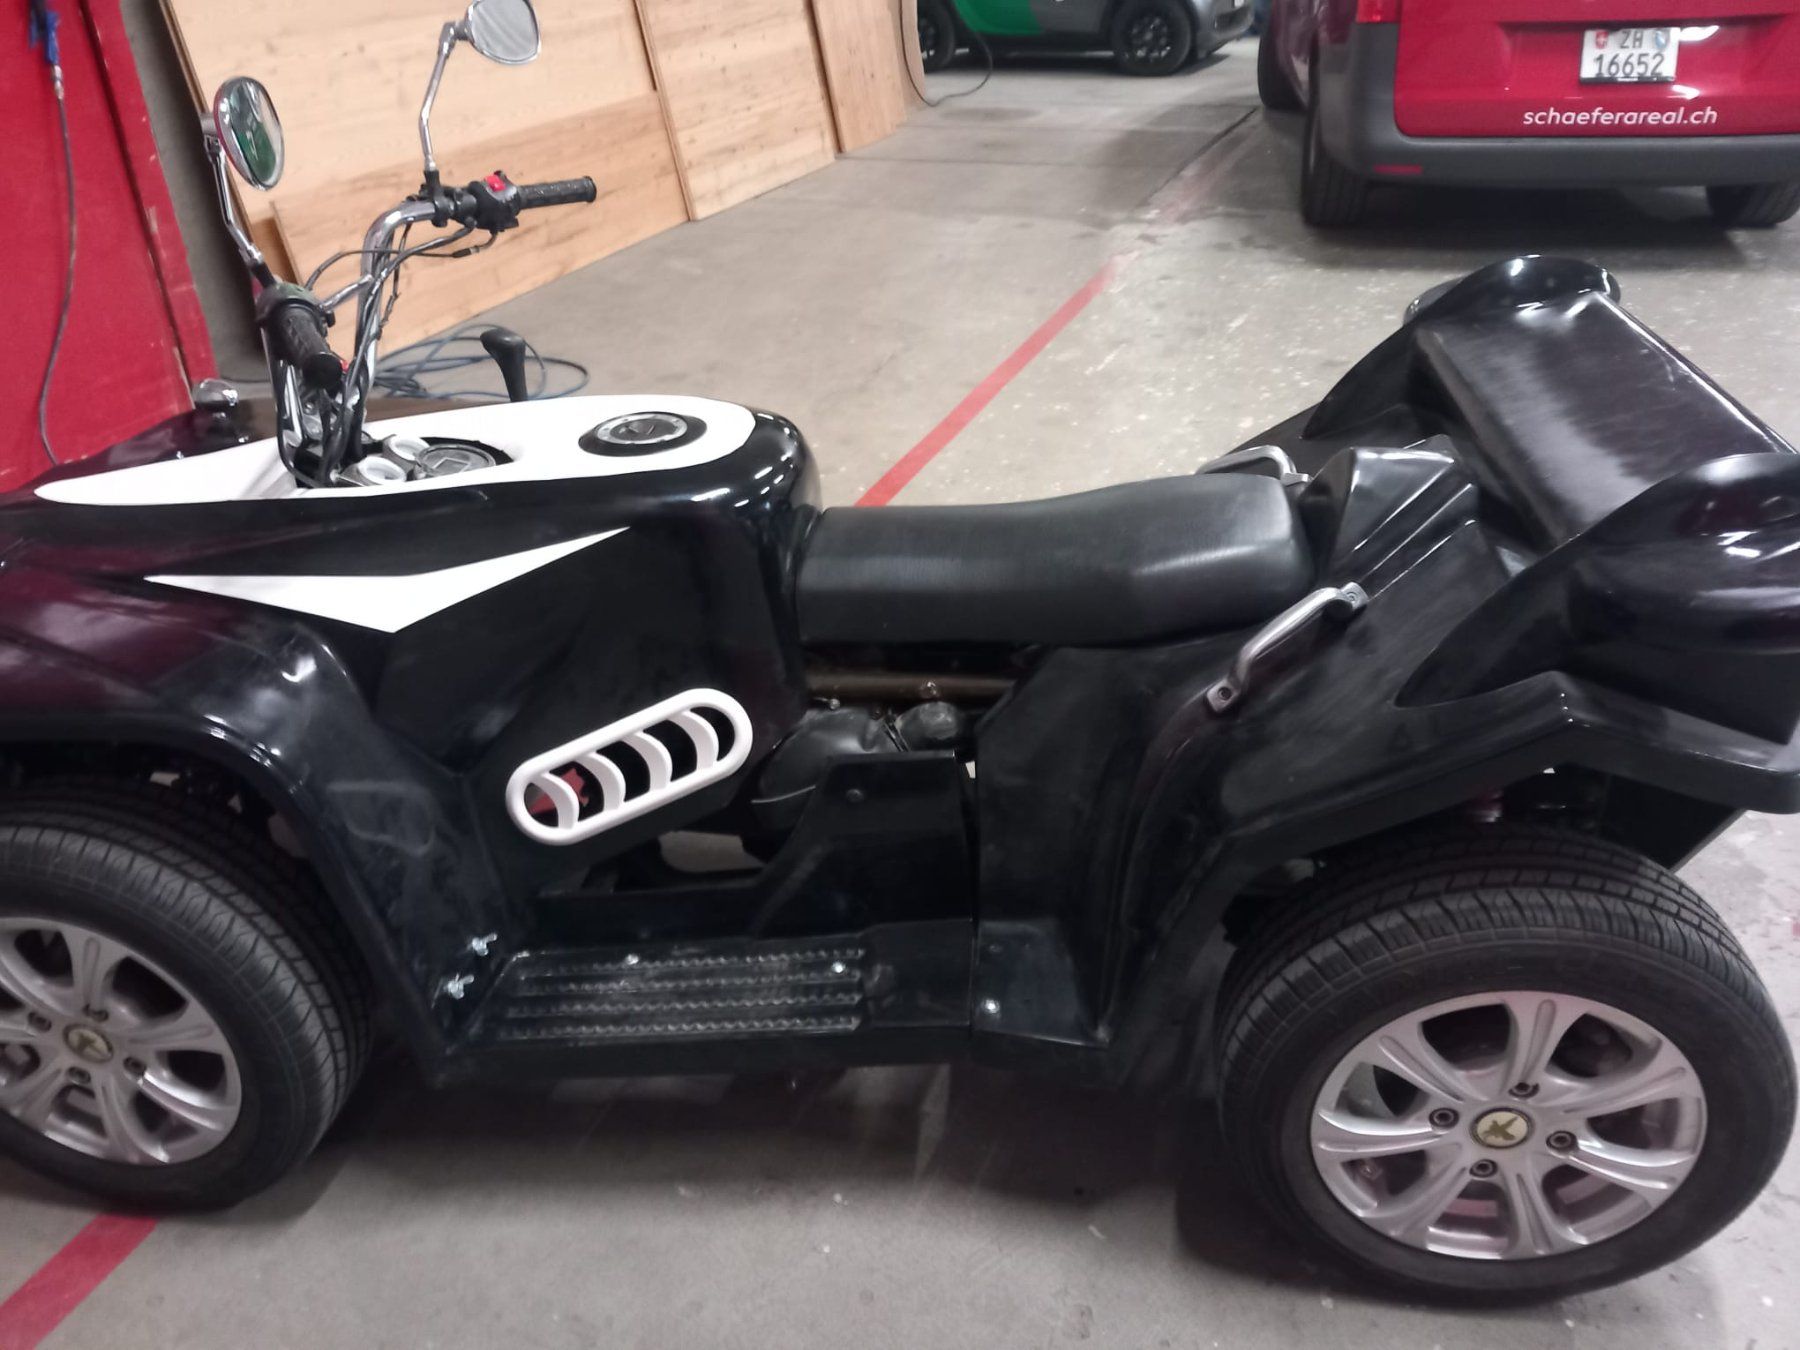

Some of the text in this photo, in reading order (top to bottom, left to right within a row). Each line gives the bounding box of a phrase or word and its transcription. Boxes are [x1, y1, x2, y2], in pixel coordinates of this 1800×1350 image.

[1619, 31, 1644, 49] ZH
[1593, 53, 1665, 77] 16652
[1523, 106, 1718, 125] schaeferareal.ch
